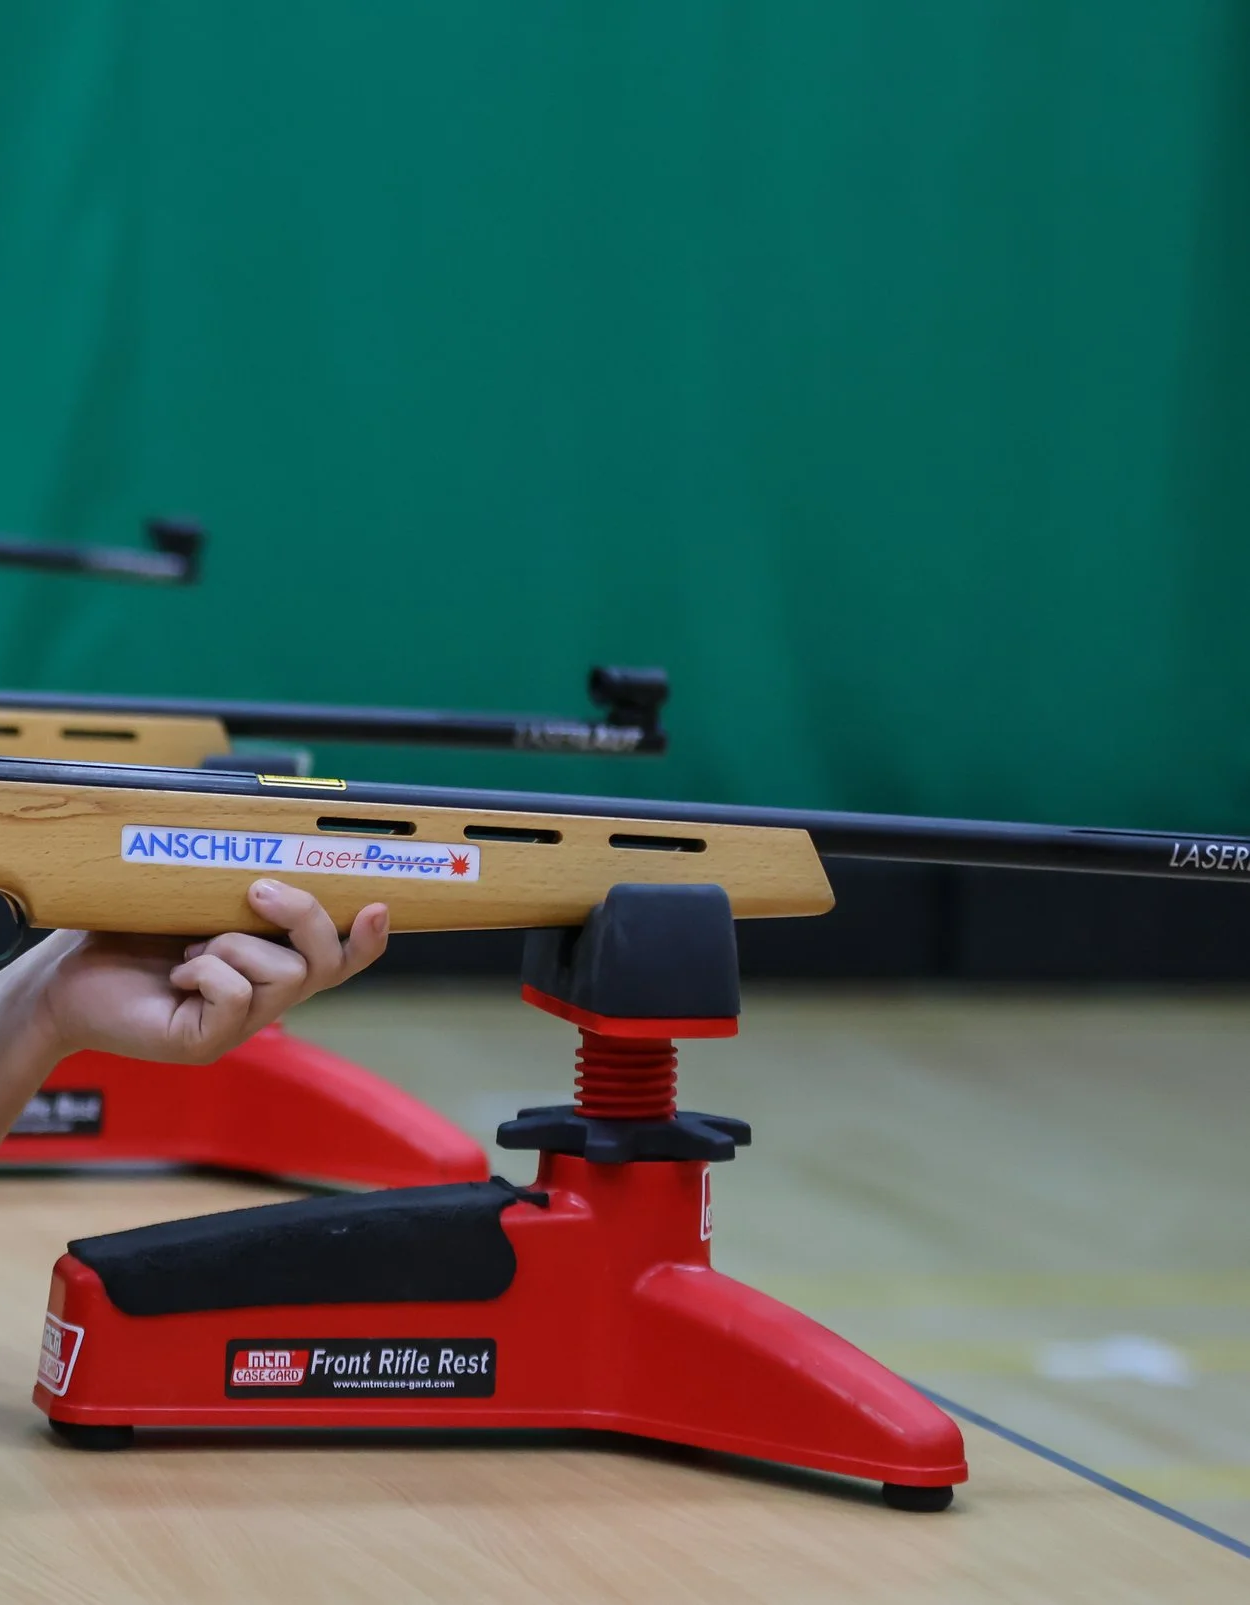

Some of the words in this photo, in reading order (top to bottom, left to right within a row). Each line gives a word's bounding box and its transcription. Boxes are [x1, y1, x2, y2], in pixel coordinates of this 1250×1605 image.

[1169, 842, 1250, 871] LASER
[311, 1348, 371, 1375] Front
[378, 1348, 430, 1374] Rifle
[438, 1348, 489, 1375] Rest
[236, 1370, 299, 1381] CASE-GARD
[333, 1379, 455, 1390] www.mtmcase-gard.com
